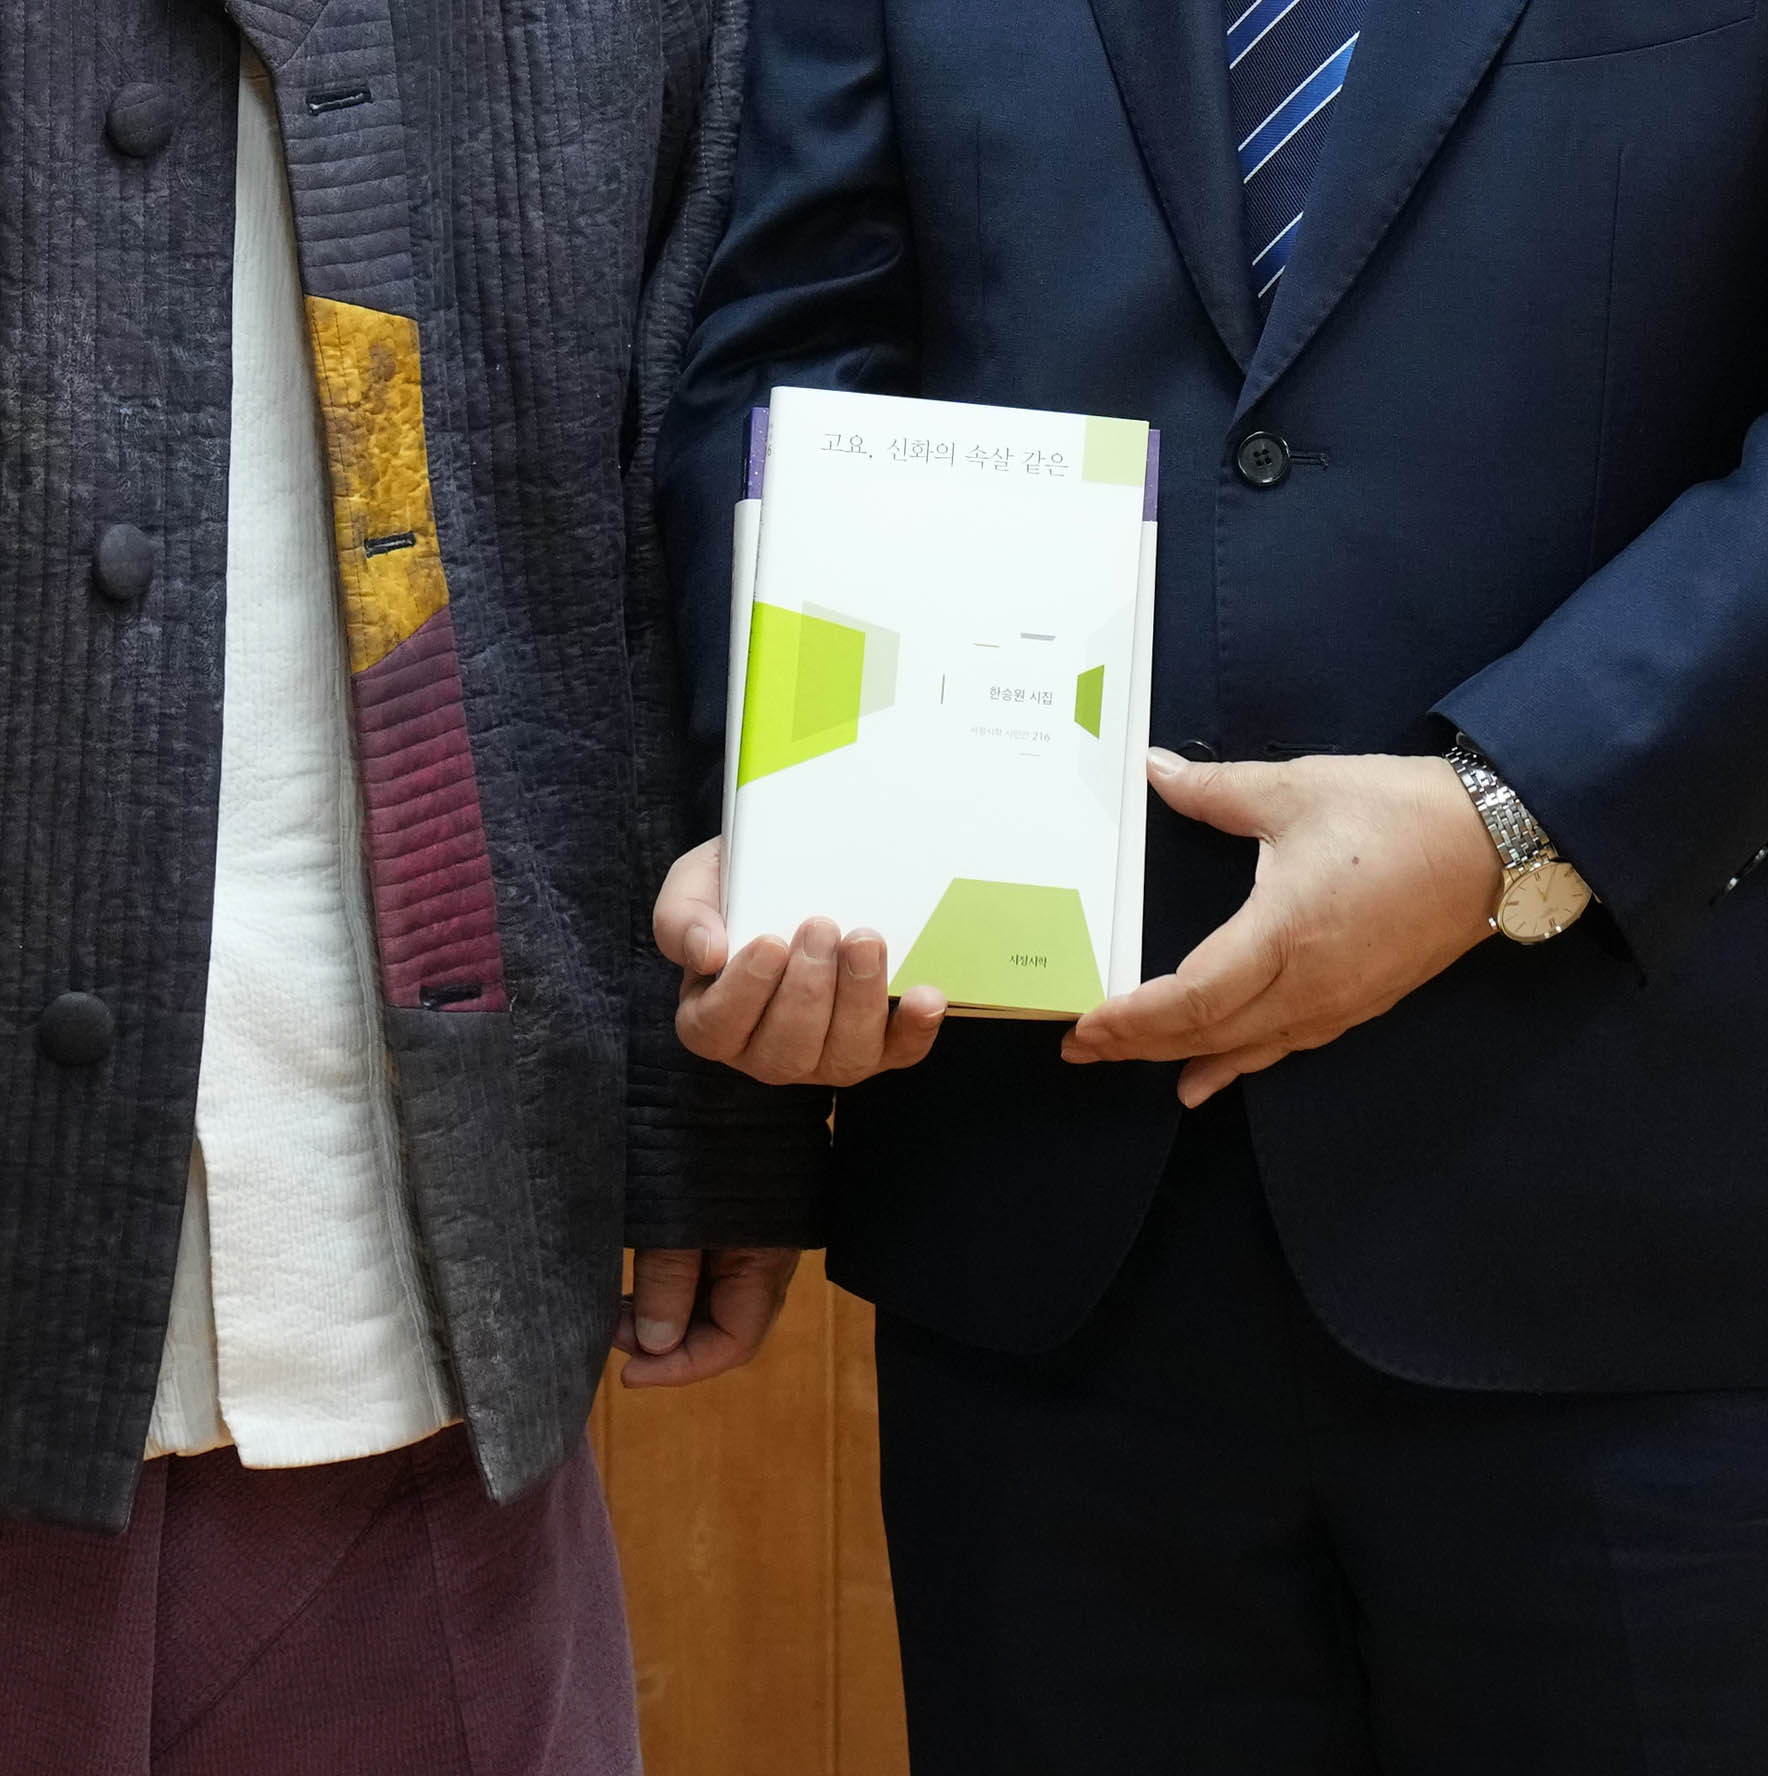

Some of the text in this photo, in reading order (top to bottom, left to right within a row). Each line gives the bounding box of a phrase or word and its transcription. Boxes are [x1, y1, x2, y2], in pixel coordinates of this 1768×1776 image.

[820, 433, 1070, 478] 고요, 신화의 속살 같은
[990, 686, 1053, 705] 한승원 시집
